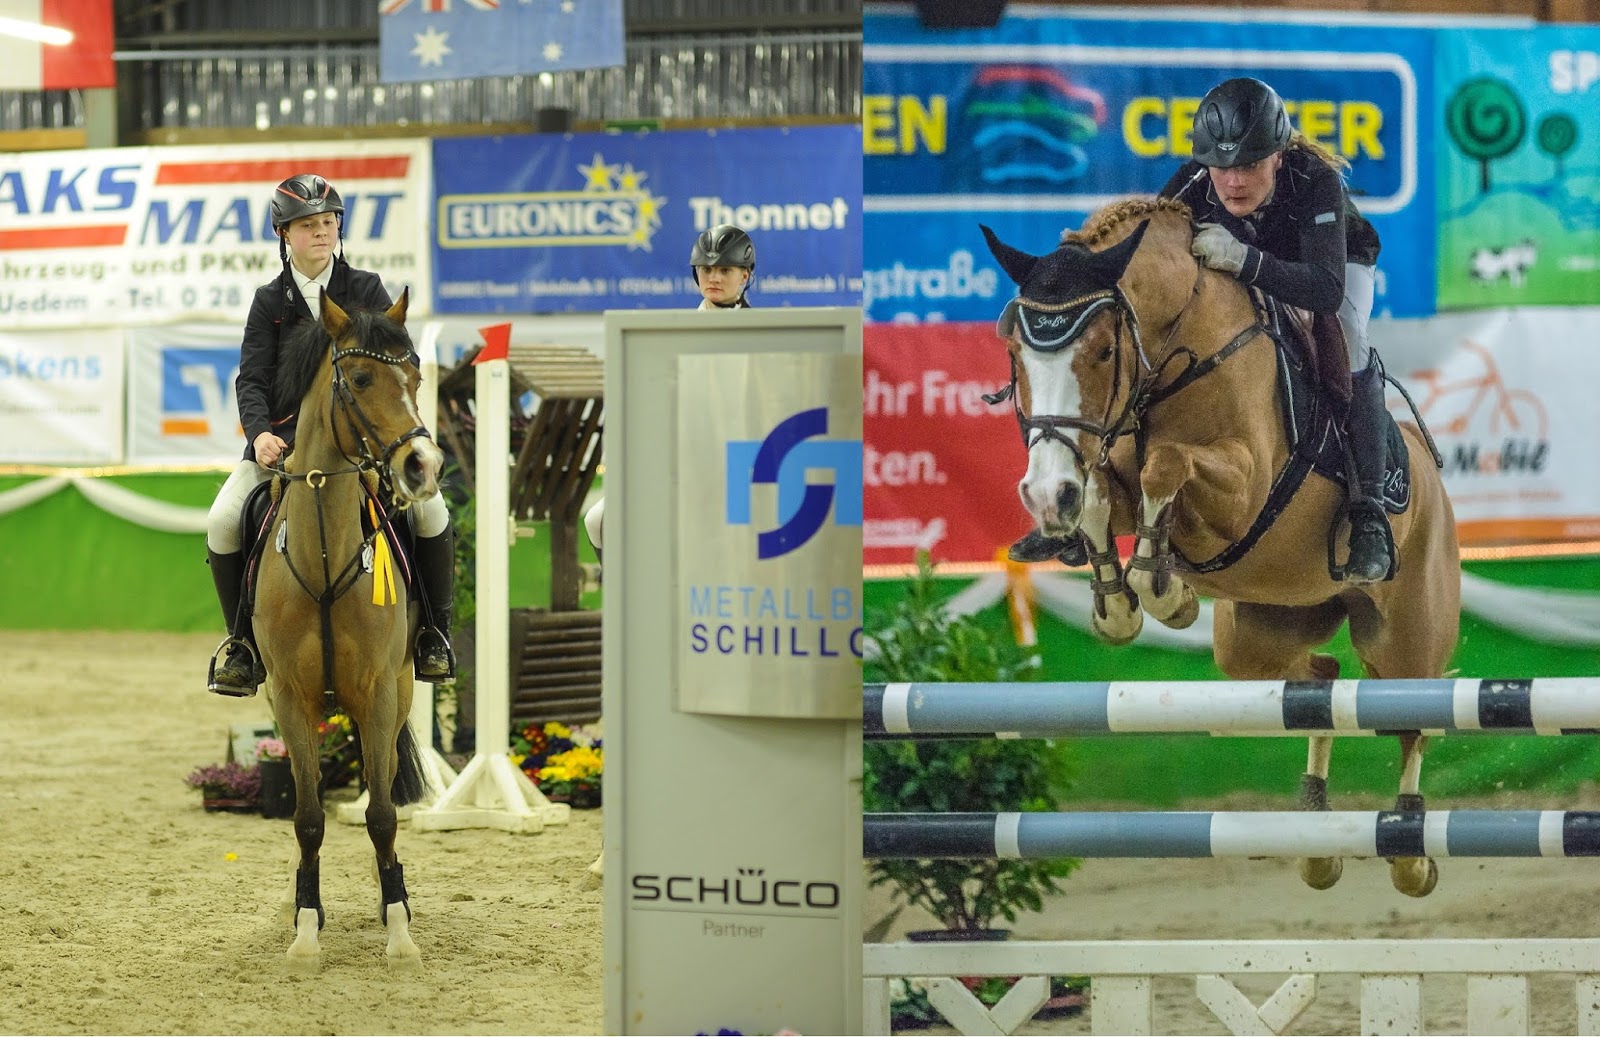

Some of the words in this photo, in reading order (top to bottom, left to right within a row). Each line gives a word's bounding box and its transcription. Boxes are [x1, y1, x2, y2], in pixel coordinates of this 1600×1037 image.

[863, 95, 947, 154] EN
[1122, 97, 1385, 159] CEER
[0, 165, 141, 214] AKS
[451, 201, 634, 237] EURONICS
[689, 197, 848, 231] Thonnet
[131, 255, 187, 275] und
[863, 446, 947, 486] ten.
[690, 585, 863, 621] METALLB
[632, 868, 840, 909] SCHÜCO
[703, 919, 765, 939] Partner
